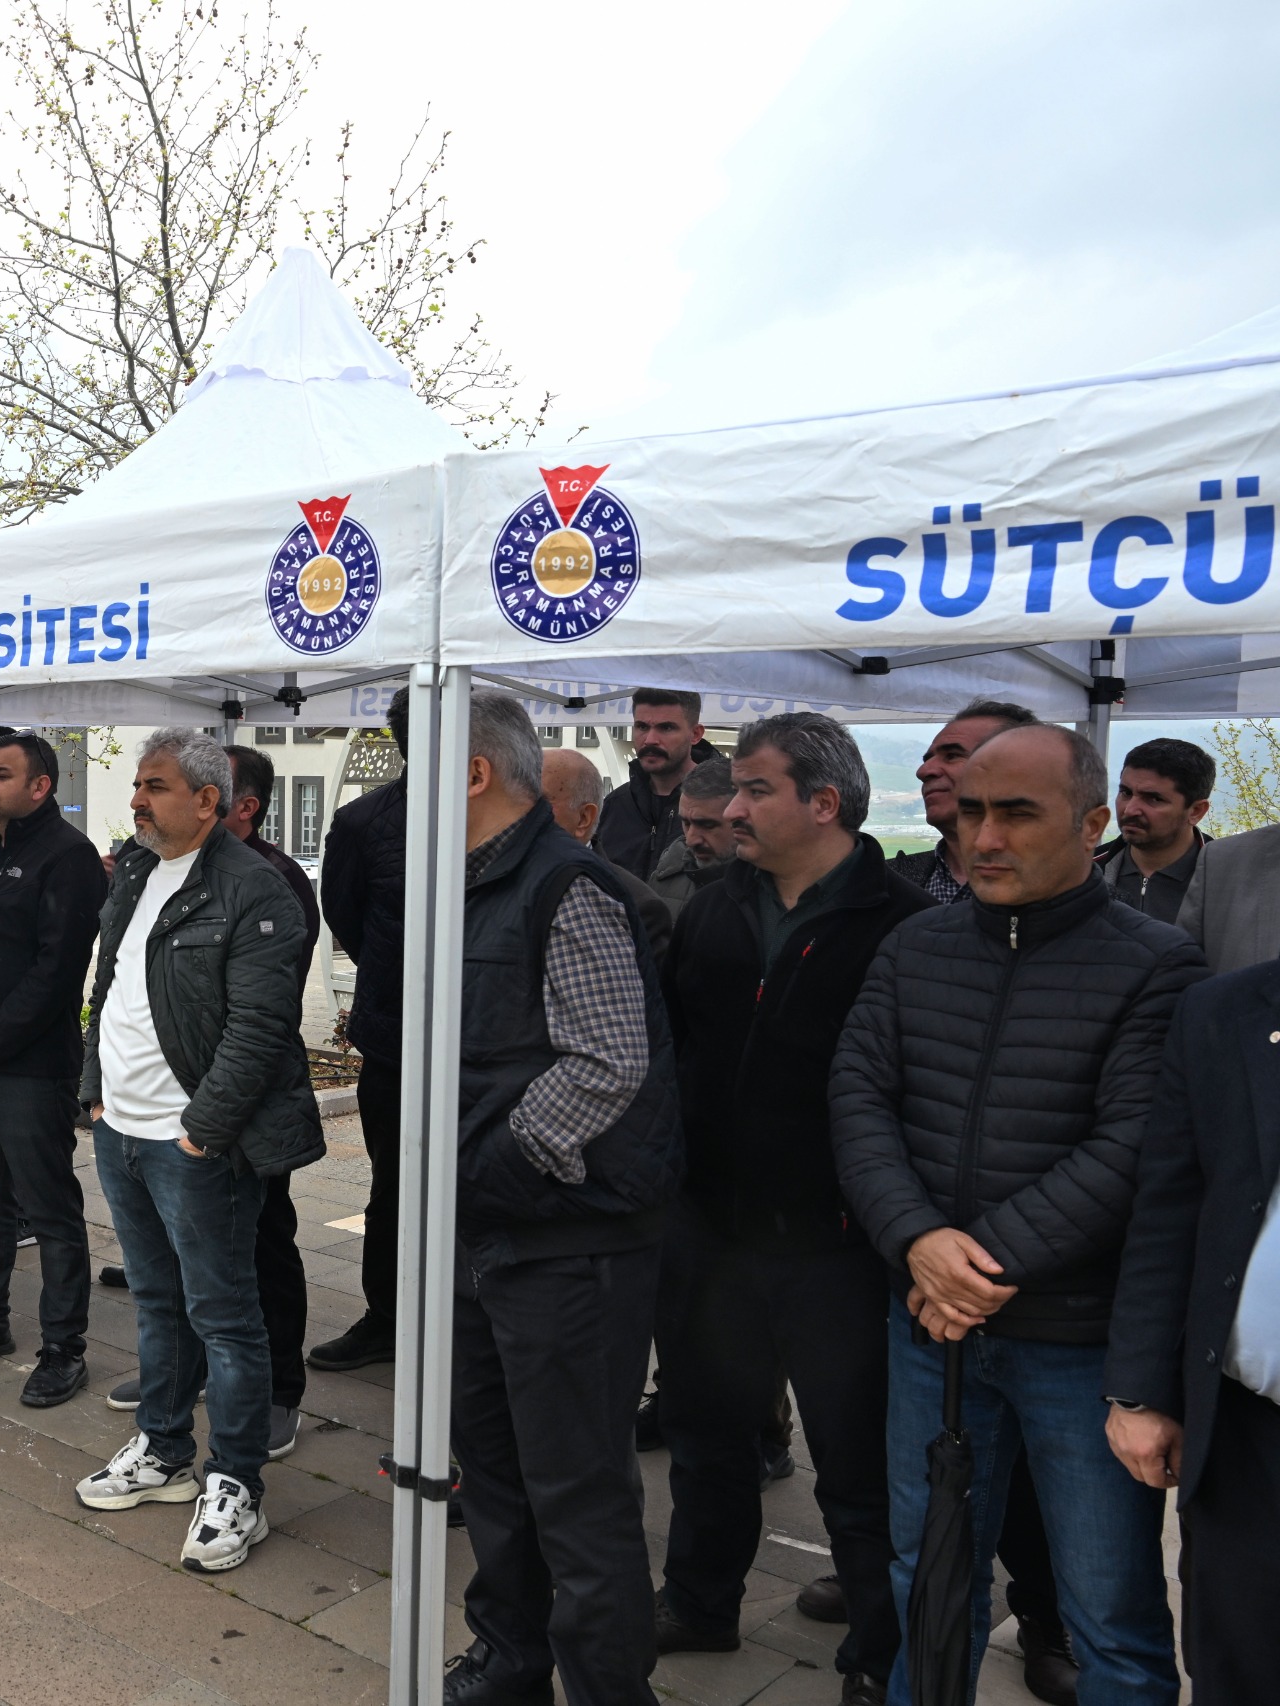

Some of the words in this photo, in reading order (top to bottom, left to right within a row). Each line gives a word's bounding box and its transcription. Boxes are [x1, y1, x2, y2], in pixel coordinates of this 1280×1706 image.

[313, 510, 335, 523] T.C.
[558, 480, 583, 493] T.C.
[271, 533, 308, 597] SÜTÇÜ
[499, 502, 544, 574] SÜTÇÜ
[516, 512, 613, 615] KAHRAMANMARAŞ
[538, 554, 589, 572] 1992
[550, 498, 633, 635] ÜNİVERSİTESİ
[835, 476, 1275, 635] SÜTÇÜ
[285, 540, 361, 632] KAHRAMANMARAŞ
[302, 577, 342, 593] 1992
[311, 527, 376, 650] ÜNİVERSİTESİ
[502, 583, 542, 632] İMAM
[274, 604, 306, 646] İMAM
